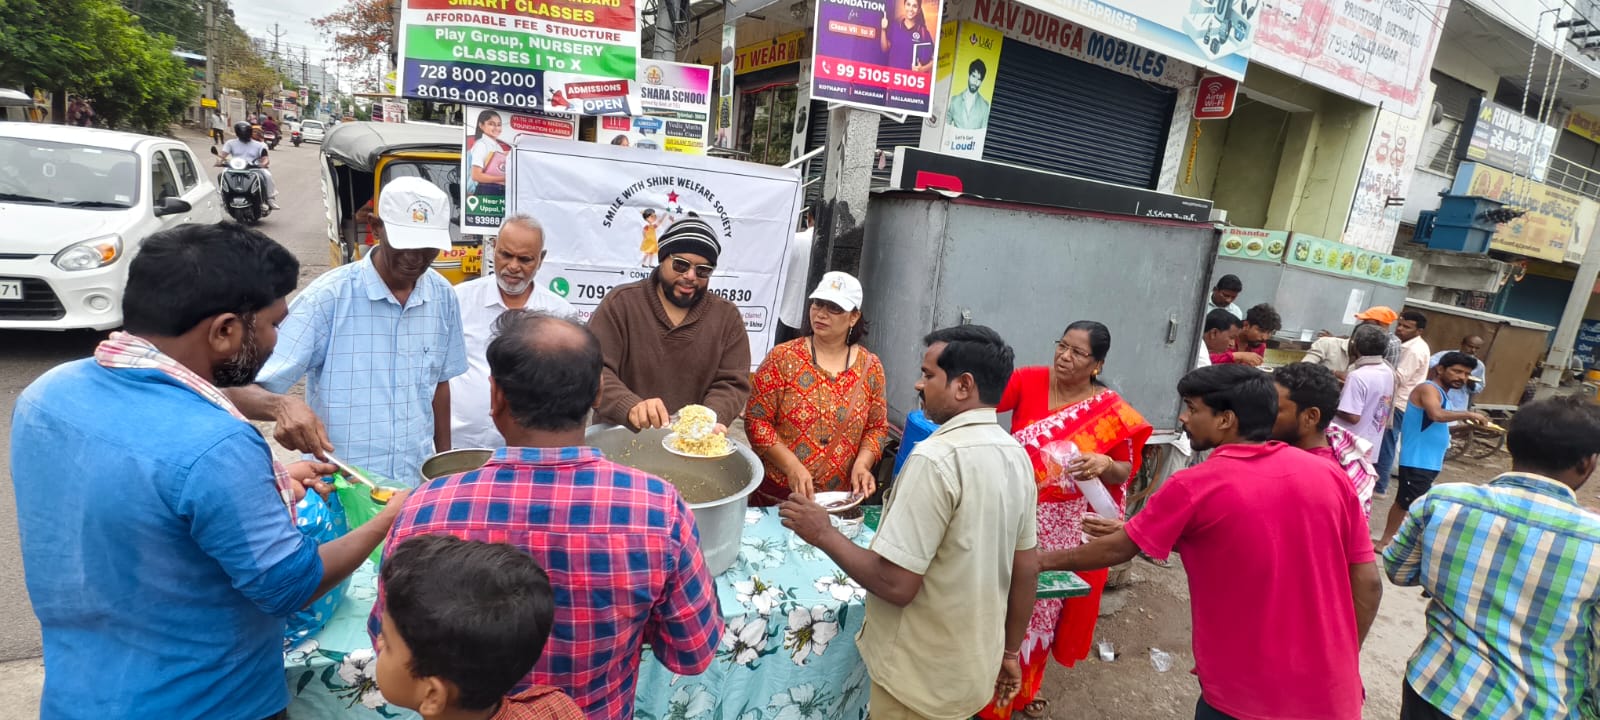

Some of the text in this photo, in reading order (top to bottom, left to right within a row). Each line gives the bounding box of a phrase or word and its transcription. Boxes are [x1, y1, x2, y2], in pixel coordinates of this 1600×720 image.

[514, 0, 595, 23] CLASSES
[823, 0, 885, 12] UNDATION
[426, 13, 621, 41] AFFORDABLE FEE STRUCTURE
[435, 28, 604, 57] Play Group, NURSERY
[973, 0, 1168, 77] NAV DURGA MOBILES
[452, 46, 582, 71] CLASSES I To X
[735, 43, 787, 71] OT WEAR
[419, 64, 536, 88] 728 800 2000
[836, 63, 925, 89] 99 5105 5105
[417, 84, 537, 108] 8019 008 009
[568, 84, 622, 95] ADMISSIONS
[641, 86, 671, 101] SHARA
[672, 91, 706, 105] SCHOOL
[818, 84, 847, 93] KOTHAPET
[853, 89, 884, 99] NACHARAM
[1205, 92, 1226, 101] Airtel
[584, 98, 623, 111] OPEN
[513, 122, 571, 135] FOUNDATION CLASSES
[950, 141, 976, 151] Loud!
[603, 176, 732, 238] SMILE WITH SHINE WELFARE SOCIETY
[1230, 228, 1270, 238] Bhandar
[630, 271, 649, 279] CONT
